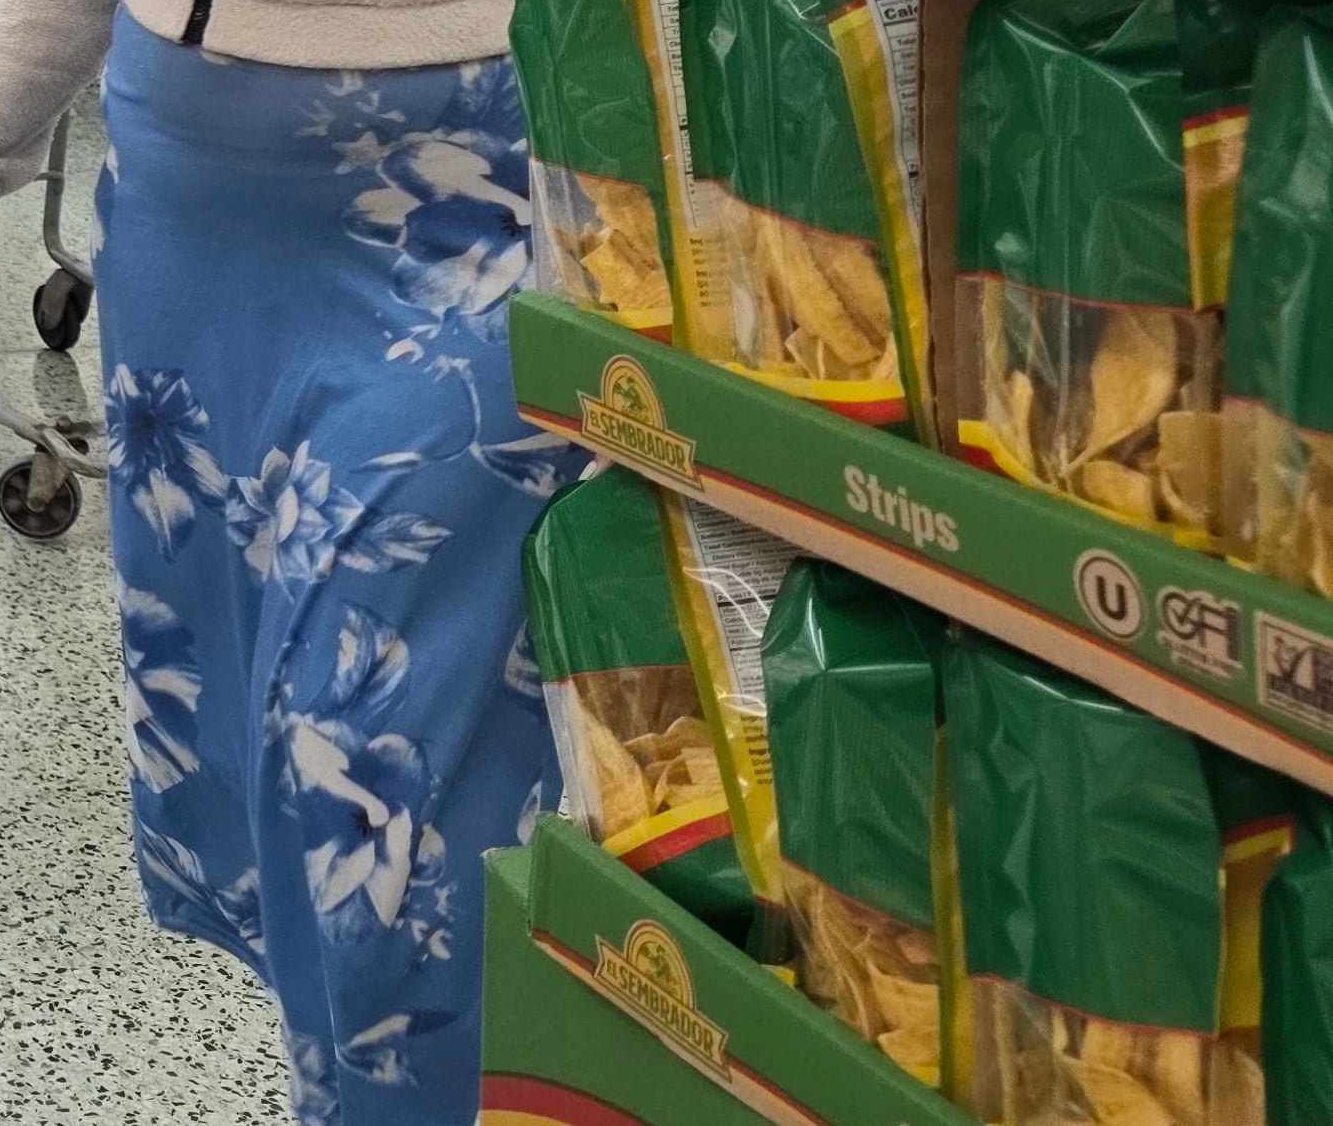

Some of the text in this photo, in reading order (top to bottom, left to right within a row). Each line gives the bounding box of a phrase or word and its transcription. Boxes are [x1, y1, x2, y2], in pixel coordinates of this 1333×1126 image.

[600, 411, 687, 471] SEMBRADOR
[843, 464, 961, 554] Strips
[1095, 574, 1126, 621] U
[606, 958, 715, 1059] EL SEMBRADOR
